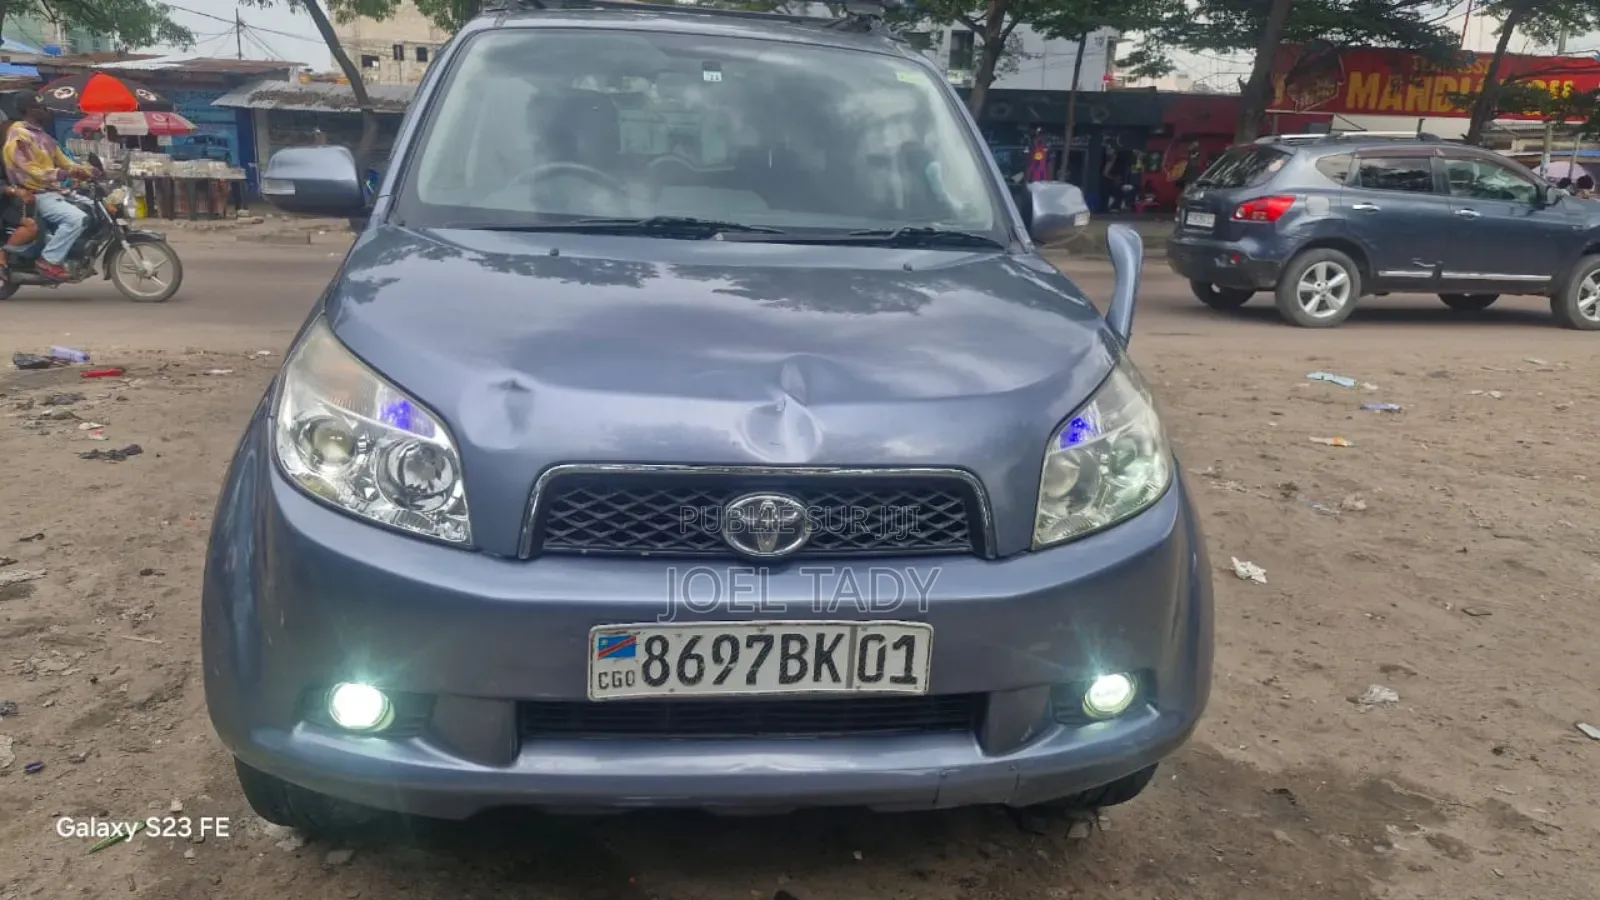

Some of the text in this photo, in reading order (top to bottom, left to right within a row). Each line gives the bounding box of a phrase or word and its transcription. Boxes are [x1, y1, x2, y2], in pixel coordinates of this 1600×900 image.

[641, 632, 919, 687] 8697BK 01
[597, 669, 636, 690] CGO
